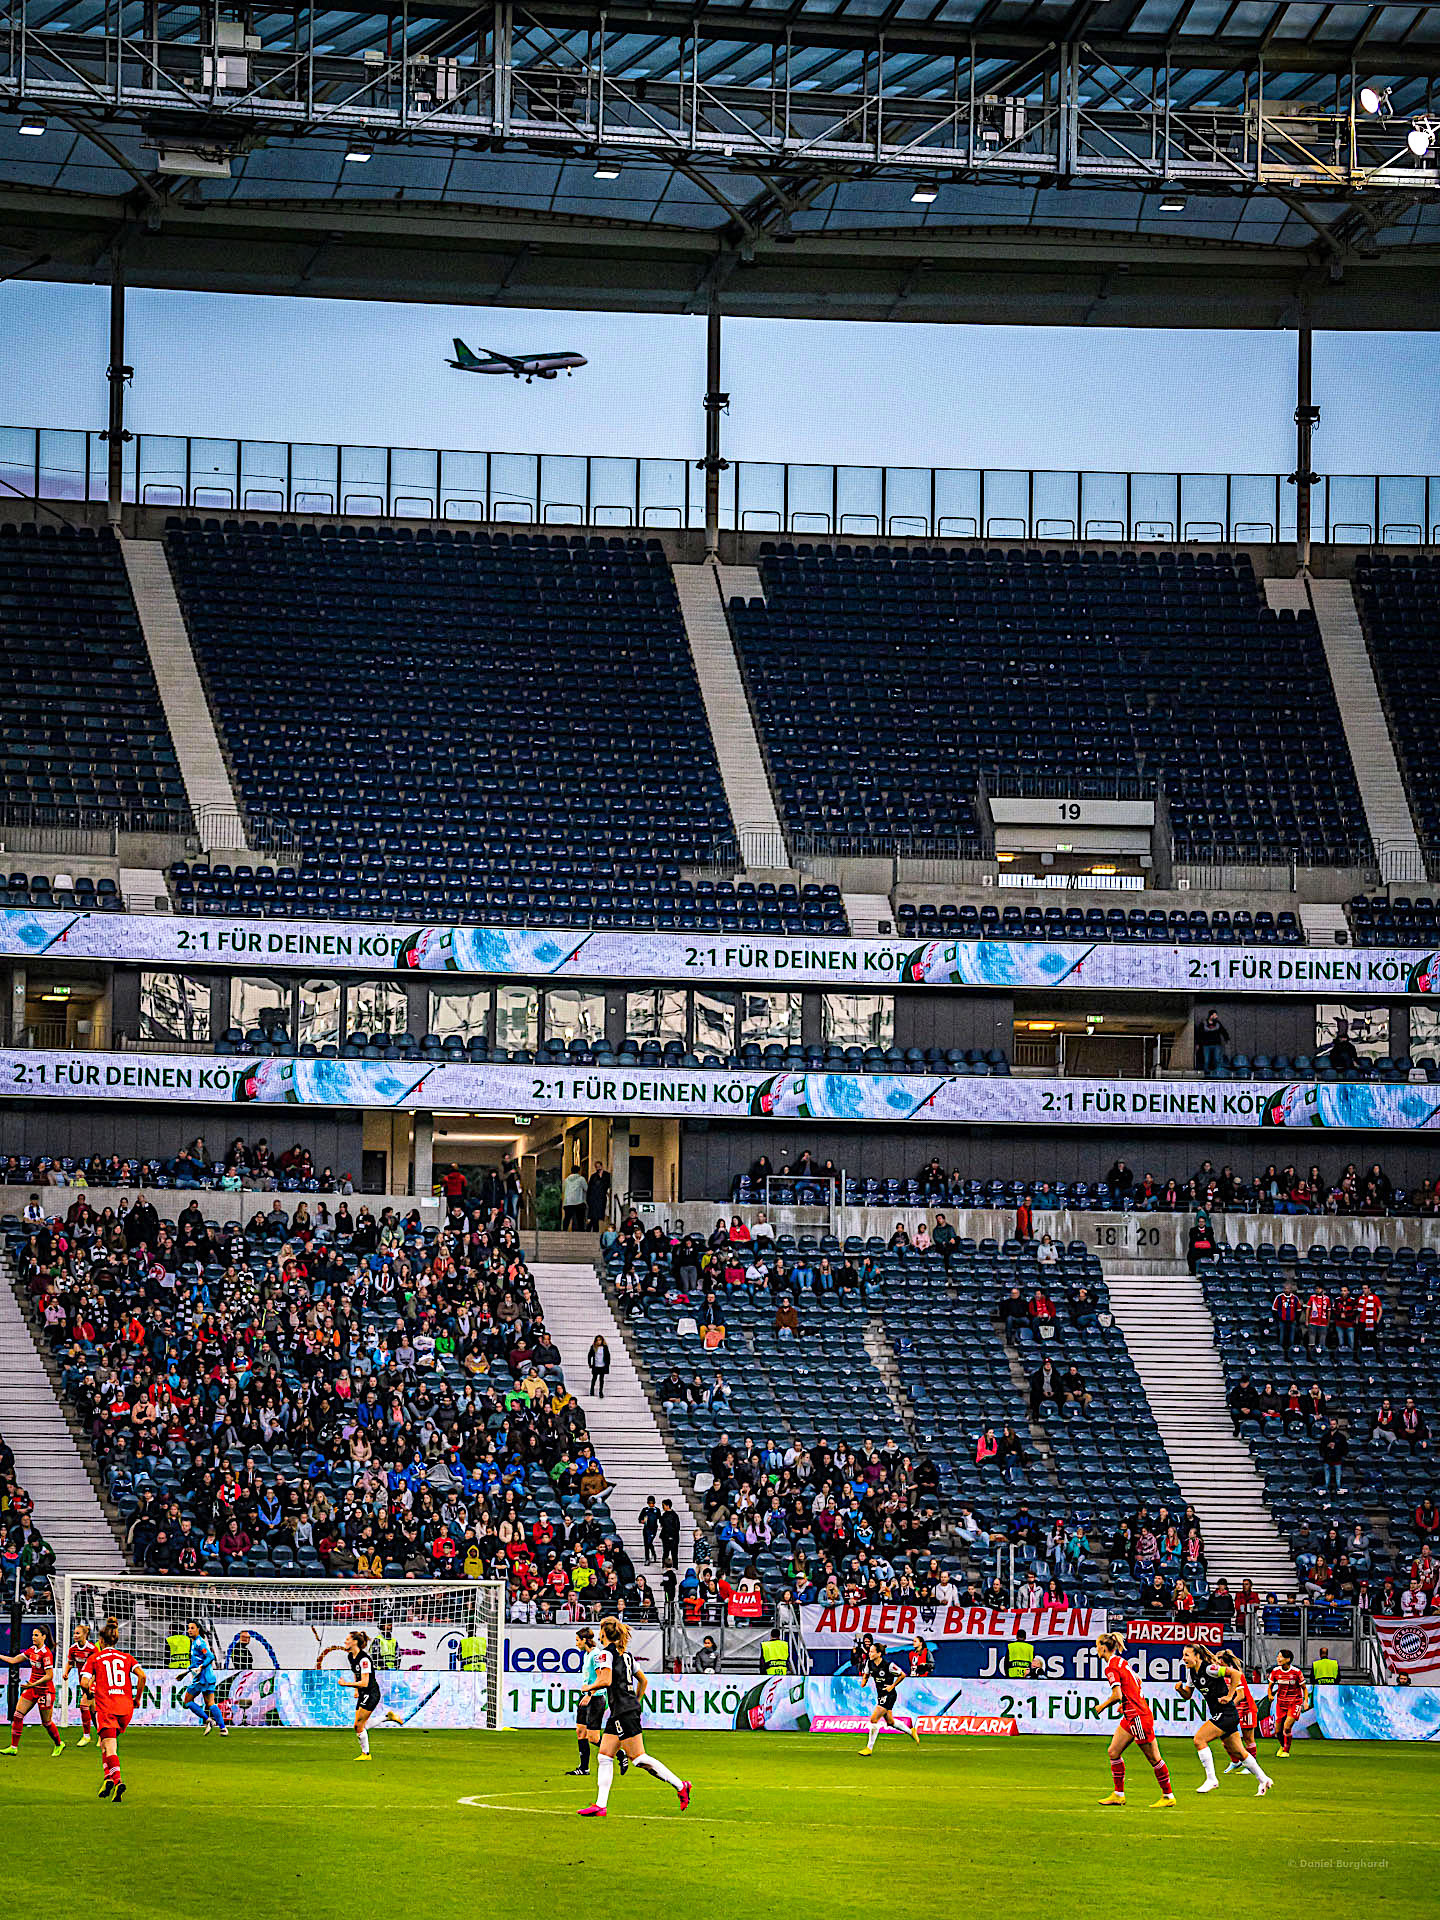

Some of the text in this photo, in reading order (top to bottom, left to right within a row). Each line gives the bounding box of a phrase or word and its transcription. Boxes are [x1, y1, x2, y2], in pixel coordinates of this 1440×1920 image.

[1058, 803, 1081, 820] 19
[177, 930, 209, 950] 2:1
[218, 927, 262, 952] FÜR
[268, 934, 351, 955] DEINEN
[685, 947, 717, 967] 2:1
[725, 943, 769, 968] FÜR
[775, 949, 857, 970] DEINEN
[1188, 959, 1220, 978] 2:1
[1229, 955, 1272, 979] FÜR
[1279, 960, 1361, 980] DEINEN
[13, 1063, 46, 1083] 2:1
[55, 1060, 100, 1085] FÜR
[106, 1066, 192, 1088] DEINEN
[532, 1079, 564, 1099] 2:1
[573, 1076, 617, 1100] FÜR
[623, 1081, 706, 1102] DEINEN
[1041, 1092, 1073, 1111] 2:1
[1082, 1088, 1126, 1112] FÜR
[1132, 1093, 1216, 1114] DEINEN
[1095, 1227, 1160, 1246] 18 20
[732, 1593, 757, 1604] LINA
[815, 1604, 1093, 1637] ADLER BRETTEN
[1128, 1623, 1222, 1643] HARZBURG
[102, 1658, 126, 1687] 16
[641, 1689, 695, 1714] NEN
[704, 1684, 742, 1714] KÖ
[1000, 1695, 1037, 1719] 2:1
[1048, 1690, 1102, 1720] FÜR
[615, 1720, 623, 1733] 8
[915, 1717, 1013, 1734] FLYERALARM
